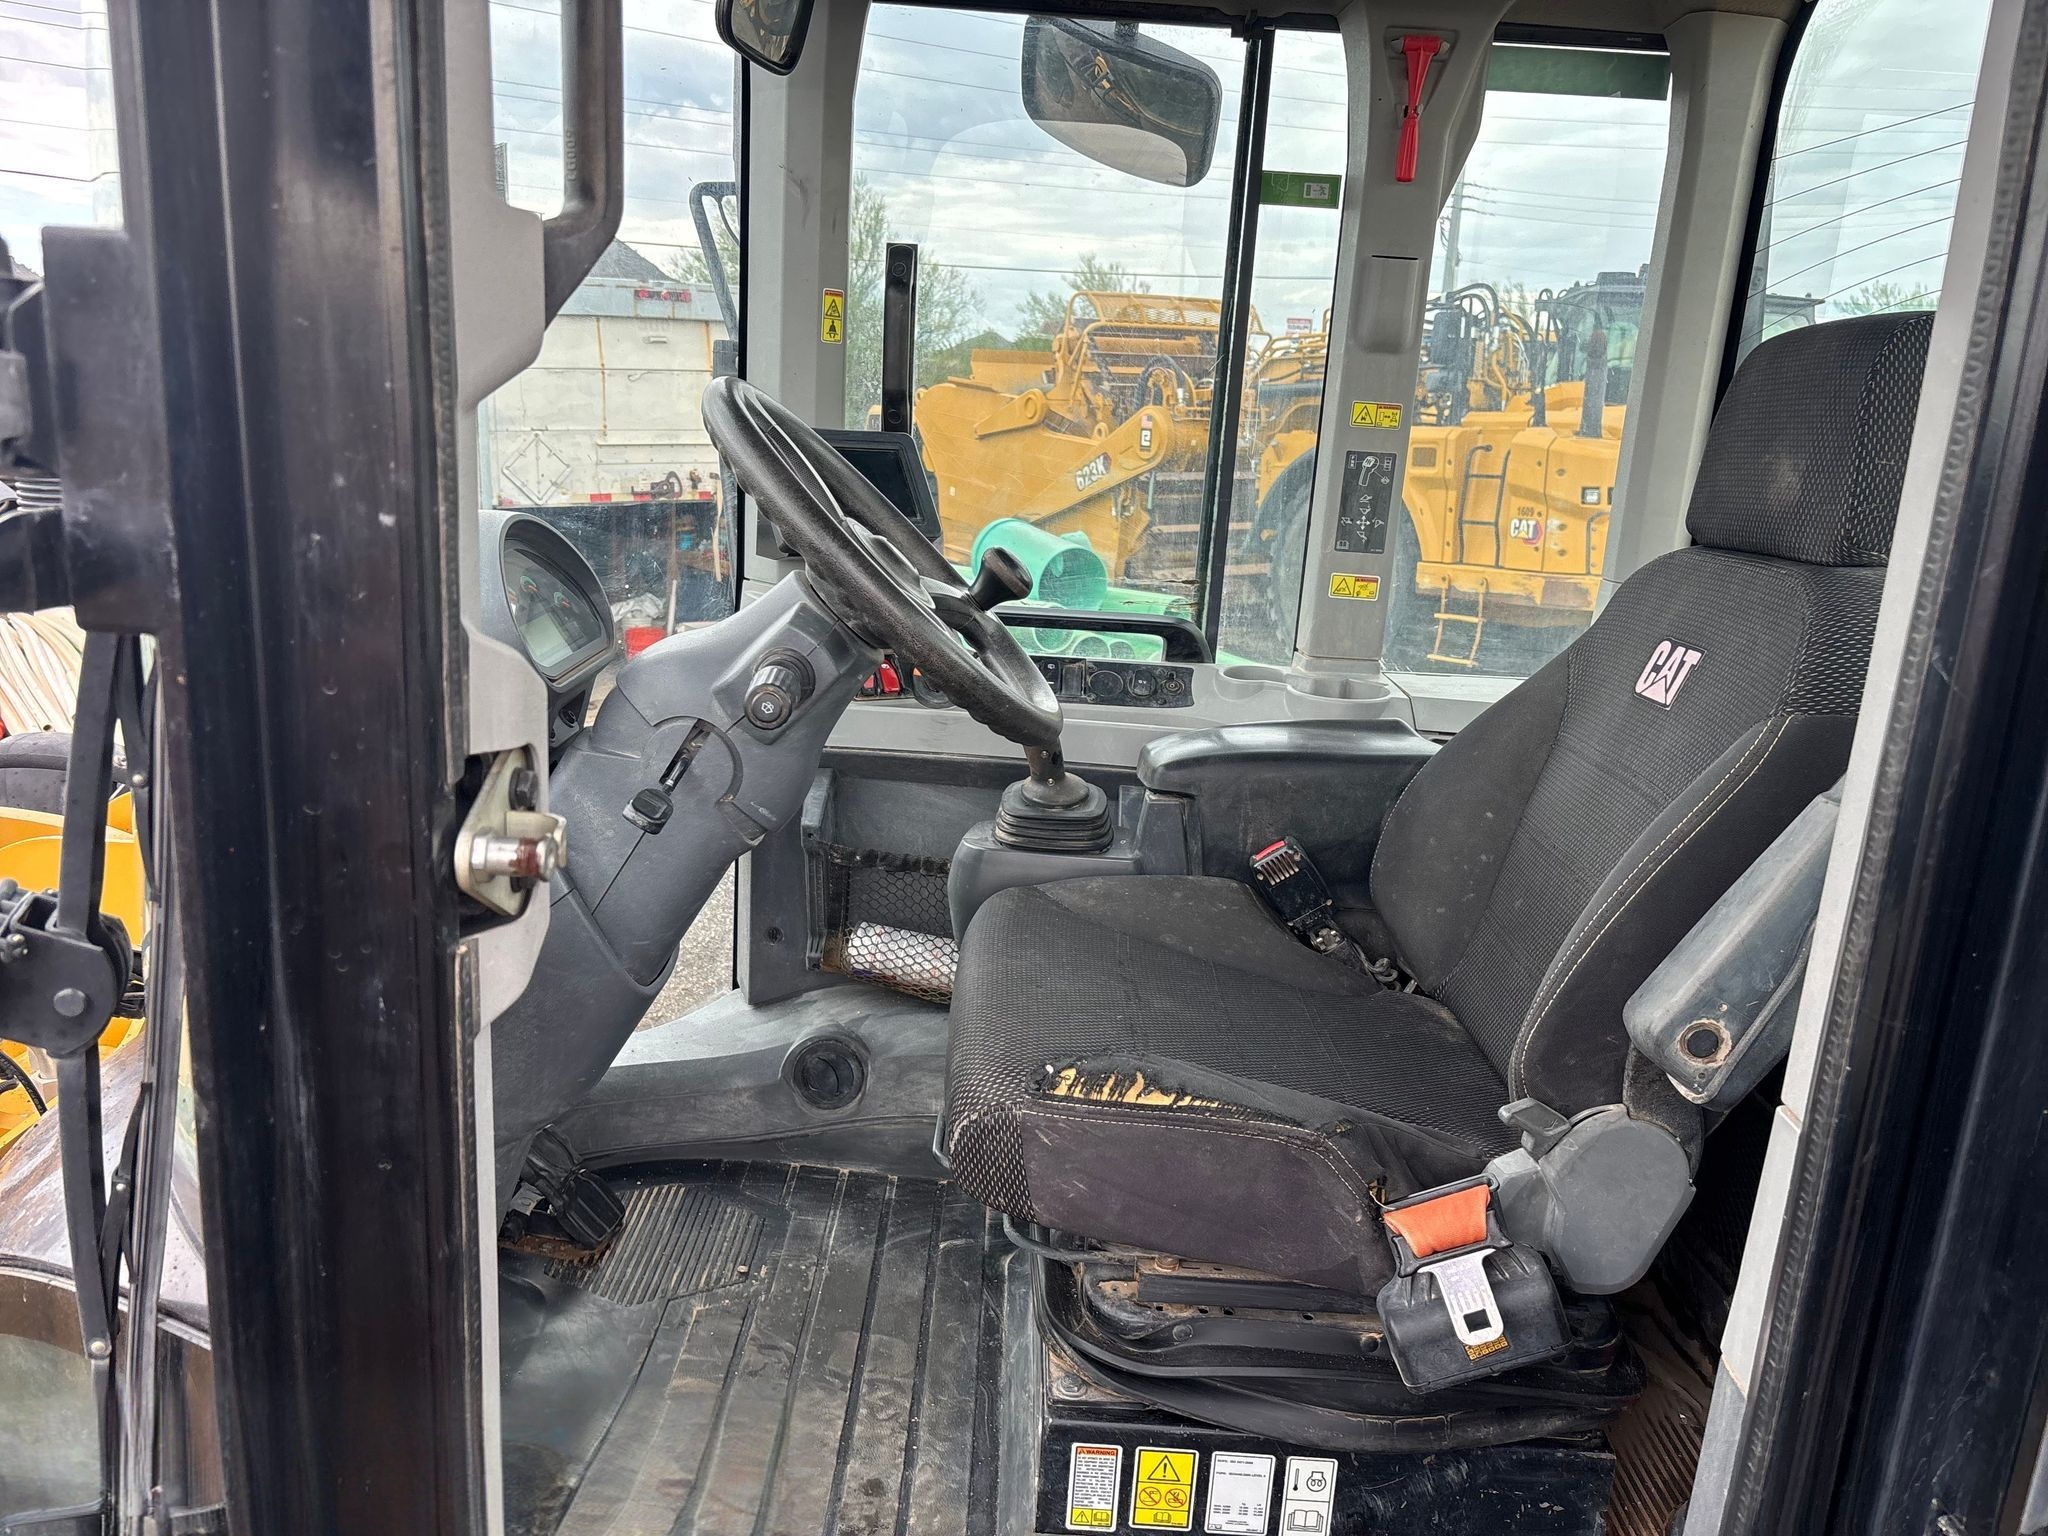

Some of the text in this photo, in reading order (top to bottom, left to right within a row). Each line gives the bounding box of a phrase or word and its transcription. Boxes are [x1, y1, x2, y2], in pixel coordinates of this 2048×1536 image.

[1075, 454, 1106, 491] 623K
[1511, 519, 1536, 539] CAT
[1635, 640, 1702, 706] CAT
[1086, 1448, 1115, 1456] WARNING
